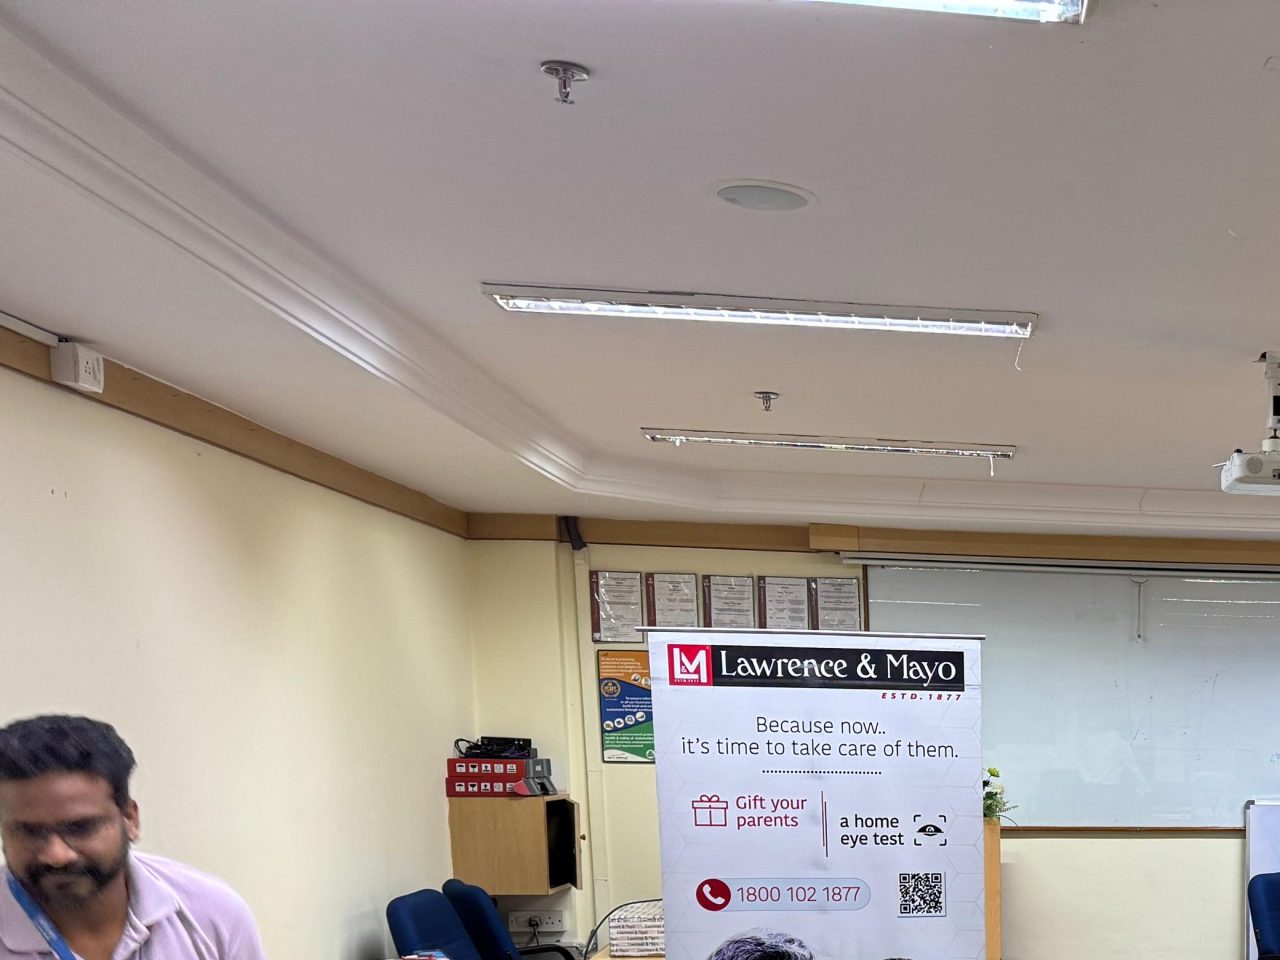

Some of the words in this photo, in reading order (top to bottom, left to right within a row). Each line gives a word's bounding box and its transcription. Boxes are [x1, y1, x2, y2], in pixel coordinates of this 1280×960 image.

[720, 650, 848, 679] Lawrence
[856, 653, 878, 679] &
[886, 653, 956, 687] Mayo
[756, 716, 833, 735] Because
[841, 720, 886, 735] now..
[681, 736, 710, 755] it's
[716, 737, 759, 756] time
[766, 740, 785, 756] to
[792, 738, 832, 757] take
[838, 743, 876, 757] care
[883, 739, 903, 758] of
[907, 740, 959, 759] them.
[736, 795, 765, 811] Gift
[771, 798, 807, 813] your
[736, 813, 799, 830] parents
[840, 816, 849, 828] a
[854, 814, 899, 828] home
[840, 834, 868, 848] eye
[872, 832, 904, 846] test
[737, 886, 781, 902] 1800
[786, 886, 817, 902] 102
[822, 886, 861, 902] 1877
